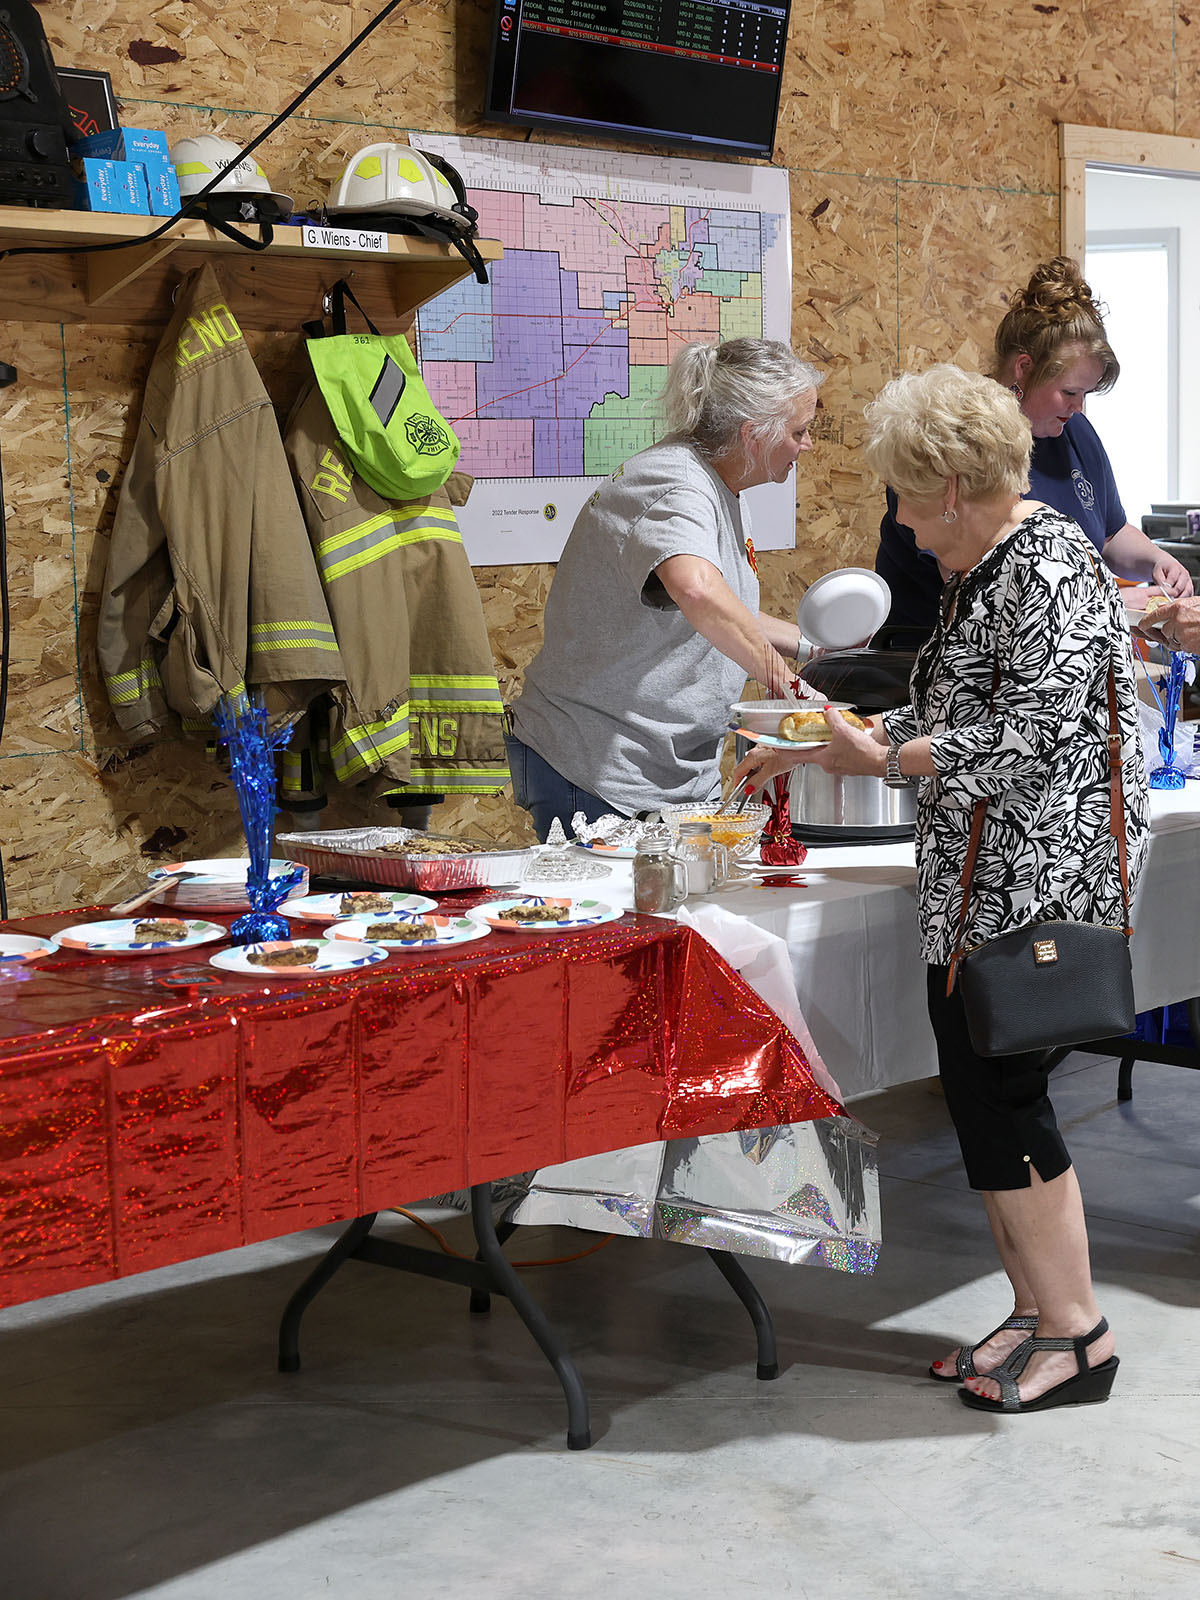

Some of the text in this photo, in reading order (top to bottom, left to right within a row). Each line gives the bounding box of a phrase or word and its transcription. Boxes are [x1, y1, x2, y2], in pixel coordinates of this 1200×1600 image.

[133, 140, 160, 150] Everyday
[215, 158, 252, 172] WINS
[98, 168, 107, 201] Everyday
[128, 172, 136, 204] Everyday
[160, 174, 169, 206] Everyday
[307, 229, 319, 244] G.
[321, 231, 350, 246] Wiens
[359, 234, 382, 248] Chief
[176, 304, 242, 368] ENO
